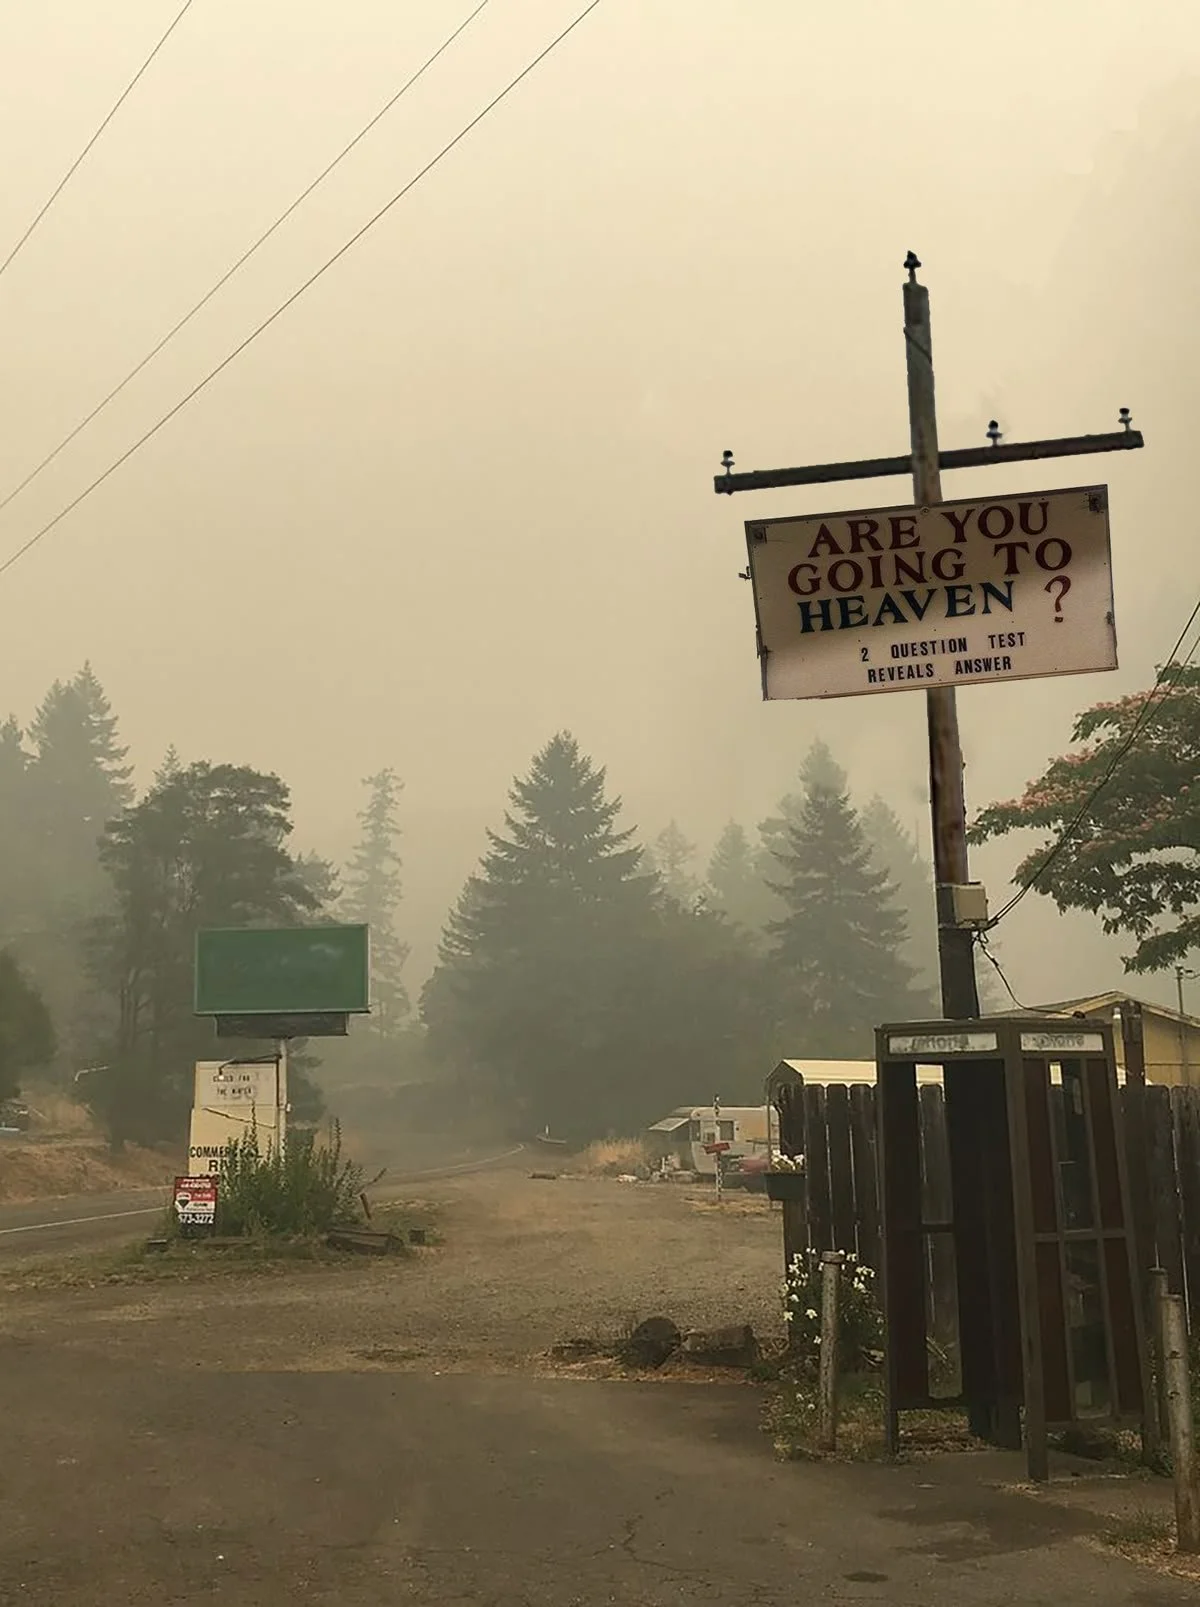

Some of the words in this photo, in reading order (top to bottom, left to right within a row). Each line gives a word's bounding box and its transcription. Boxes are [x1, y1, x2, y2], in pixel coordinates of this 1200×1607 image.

[807, 515, 921, 558] ARE
[941, 501, 1050, 543] YOU
[787, 548, 967, 596] GOING
[993, 537, 1073, 575] TO
[798, 580, 1015, 633] HEAVEN
[1043, 575, 1072, 623] ?
[860, 647, 870, 662] 2
[890, 637, 968, 659] QUESTION
[988, 631, 1026, 649] TEST
[867, 662, 935, 683] REVEALS
[955, 656, 1012, 675] ANSWER
